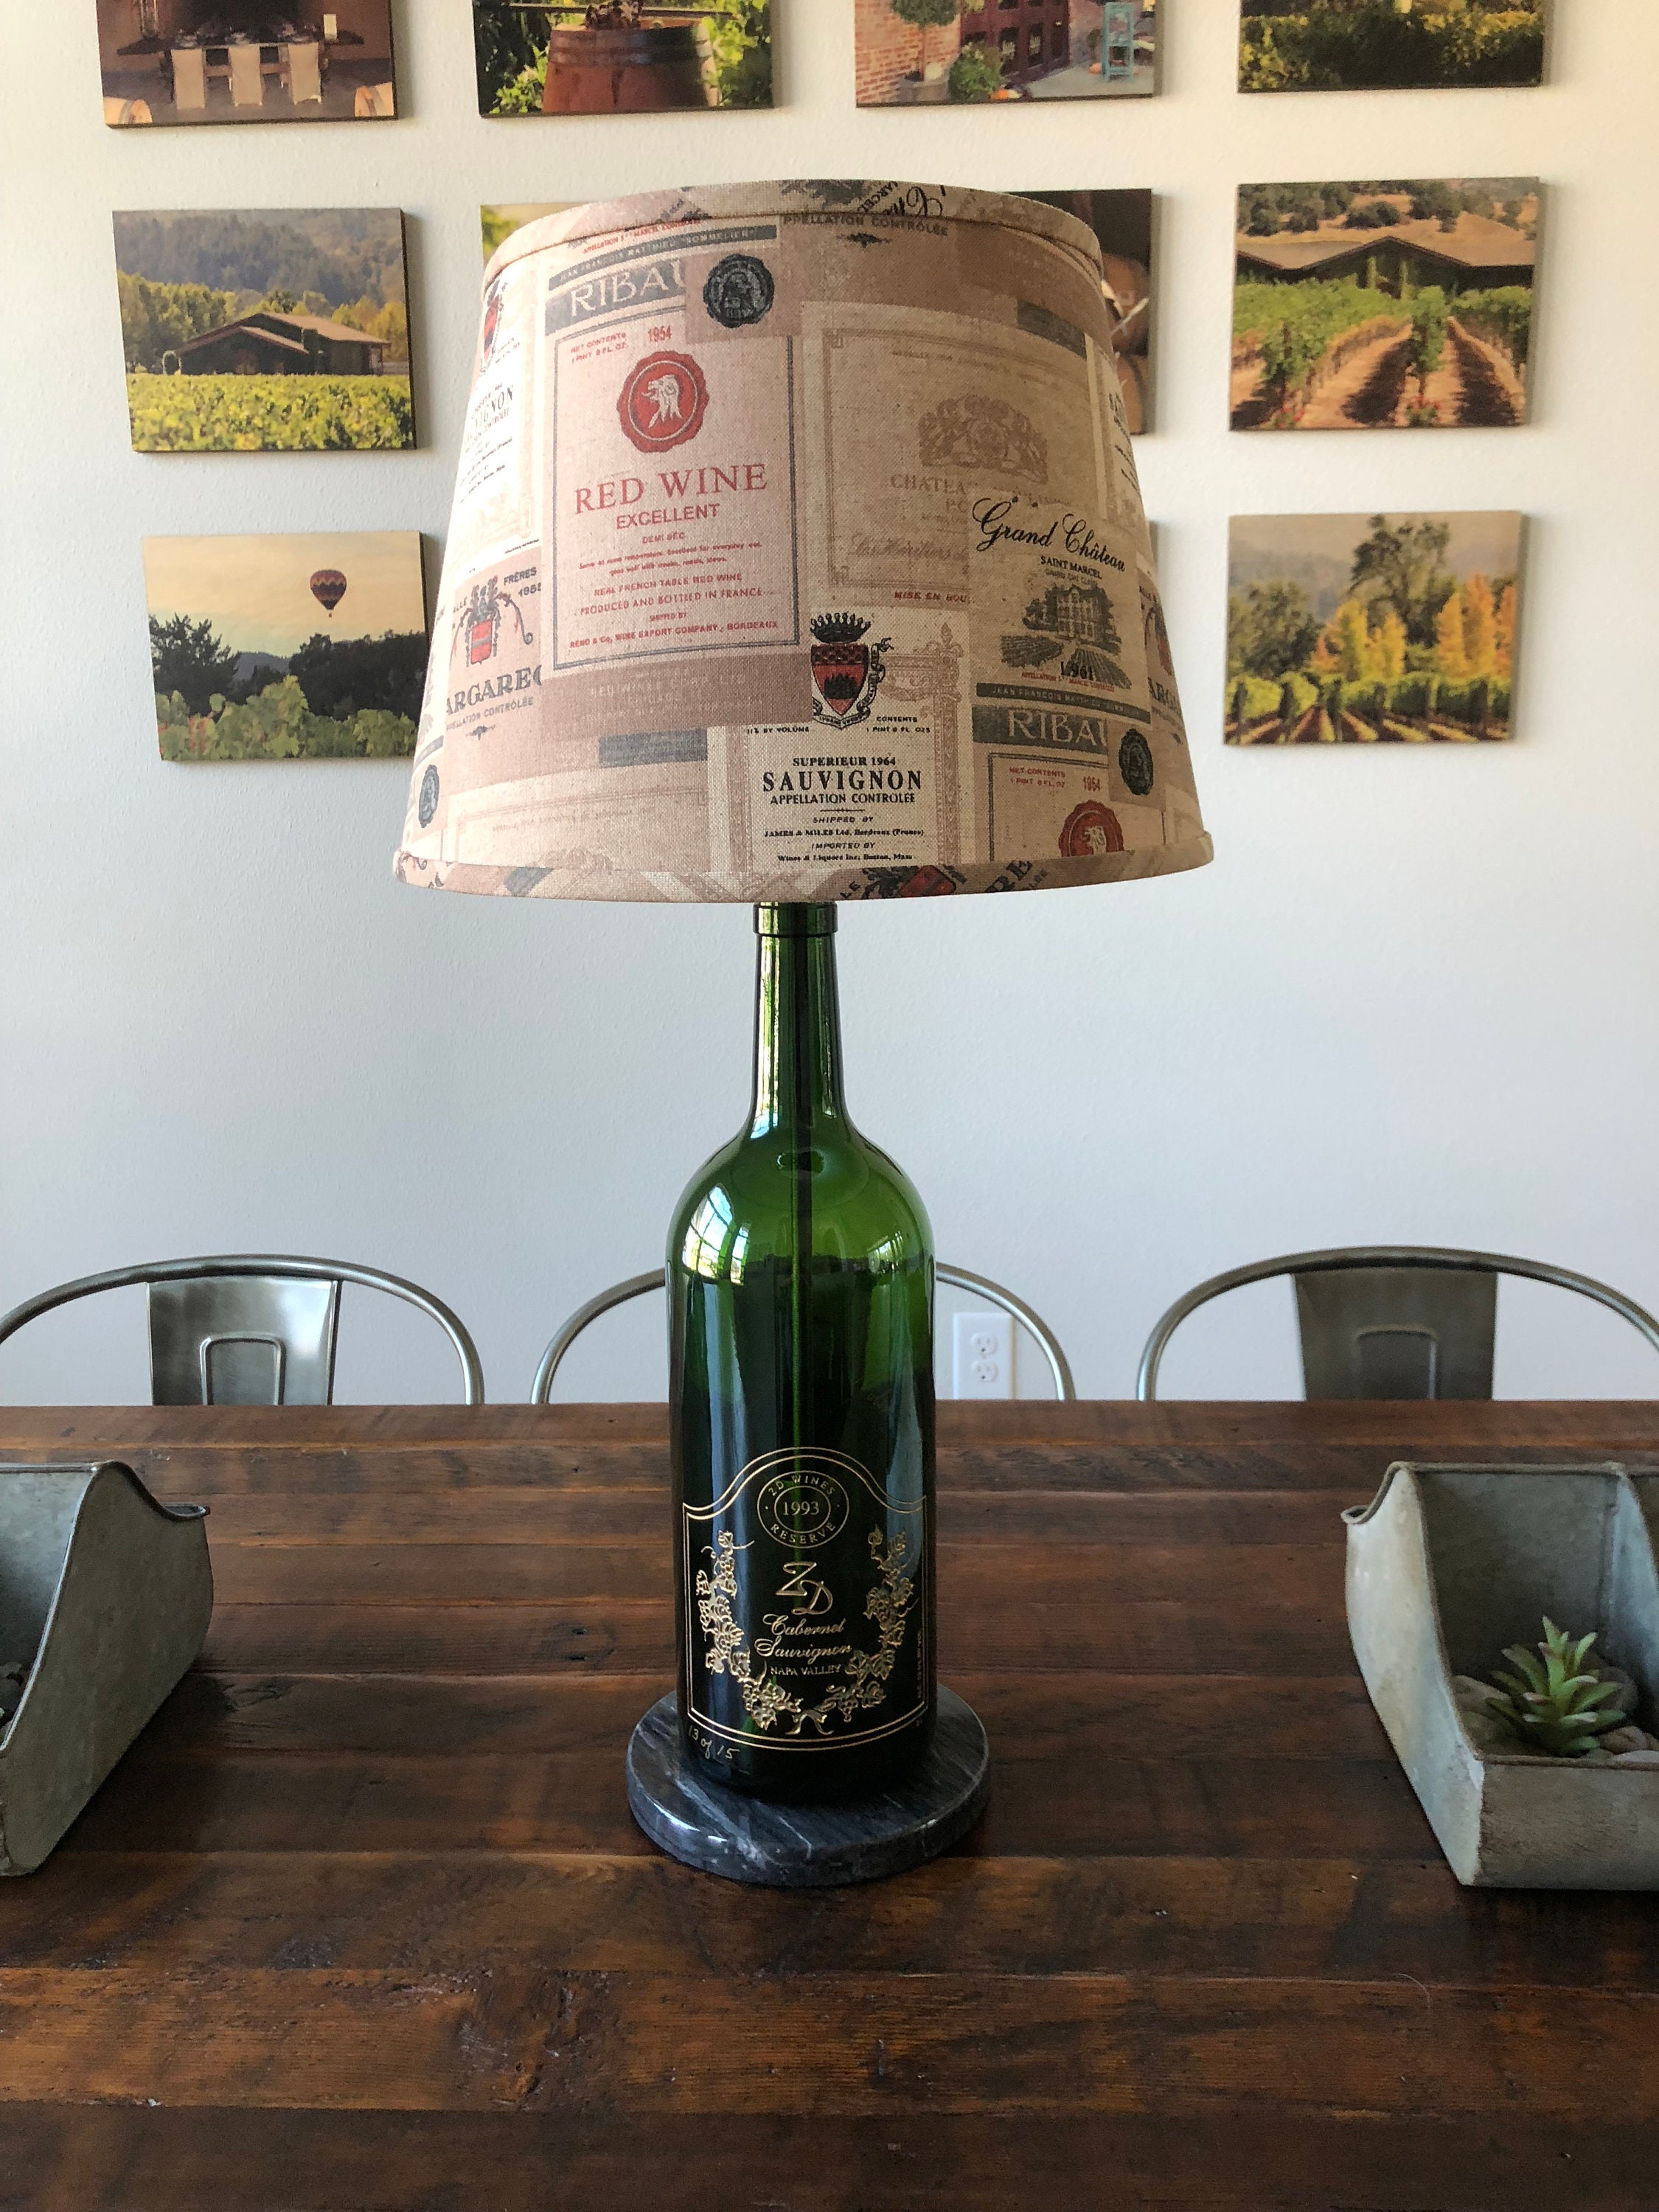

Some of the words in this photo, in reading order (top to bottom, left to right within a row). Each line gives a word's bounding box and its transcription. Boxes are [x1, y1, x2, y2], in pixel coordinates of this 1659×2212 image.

[586, 332, 626, 349] CONTENTS
[574, 477, 644, 515] RED
[658, 463, 768, 498] WINE
[616, 503, 720, 529] EXCELLENT
[642, 535, 664, 544] DEMI
[972, 497, 1060, 552] Grand
[1062, 512, 1127, 573] Château
[1040, 555, 1068, 569] SAINT
[1070, 562, 1102, 580] MARCEL
[594, 587, 616, 597] REAL
[619, 581, 657, 593] FRENCH
[660, 577, 689, 587] TABLE
[692, 574, 713, 584] RED
[717, 573, 743, 582] WINE
[580, 601, 629, 616] PRODUCED
[633, 597, 654, 608] AND
[658, 592, 701, 605] BOTTLED
[706, 590, 717, 599] IN
[720, 588, 762, 599] FRANCE
[894, 591, 922, 600] MISE
[925, 591, 942, 601] EN
[649, 613, 676, 622] SHIPPED
[615, 631, 636, 641] WINE
[639, 627, 672, 639] EXPORT
[726, 620, 778, 631] BORDEAUX
[776, 726, 810, 734] VOLUME
[793, 757, 868, 767] SUPERIEUR
[872, 757, 897, 767] 1964
[762, 769, 922, 793] SAUVIGNON
[1009, 766, 1025, 775] NET
[1026, 768, 1066, 779] CONTENTS
[1082, 776, 1101, 792] 1954
[771, 793, 846, 804] APPELLATION
[813, 815, 855, 824] SHIPPED
[764, 829, 793, 838] JAMES
[805, 829, 834, 837] MILES
[811, 841, 860, 849] IMPORTED
[768, 1481, 785, 1496] ZD
[791, 1475, 835, 1495] WINES
[782, 1500, 820, 1516] 1993
[771, 1522, 836, 1545] RESERVE
[762, 1613, 847, 1635] Cabernet
[754, 1635, 853, 1665] Sauvignon
[770, 1666, 799, 1676] NAPA
[801, 1663, 842, 1676] VALLEY
[700, 1738, 713, 1759] of
[717, 1745, 740, 1759] 15
